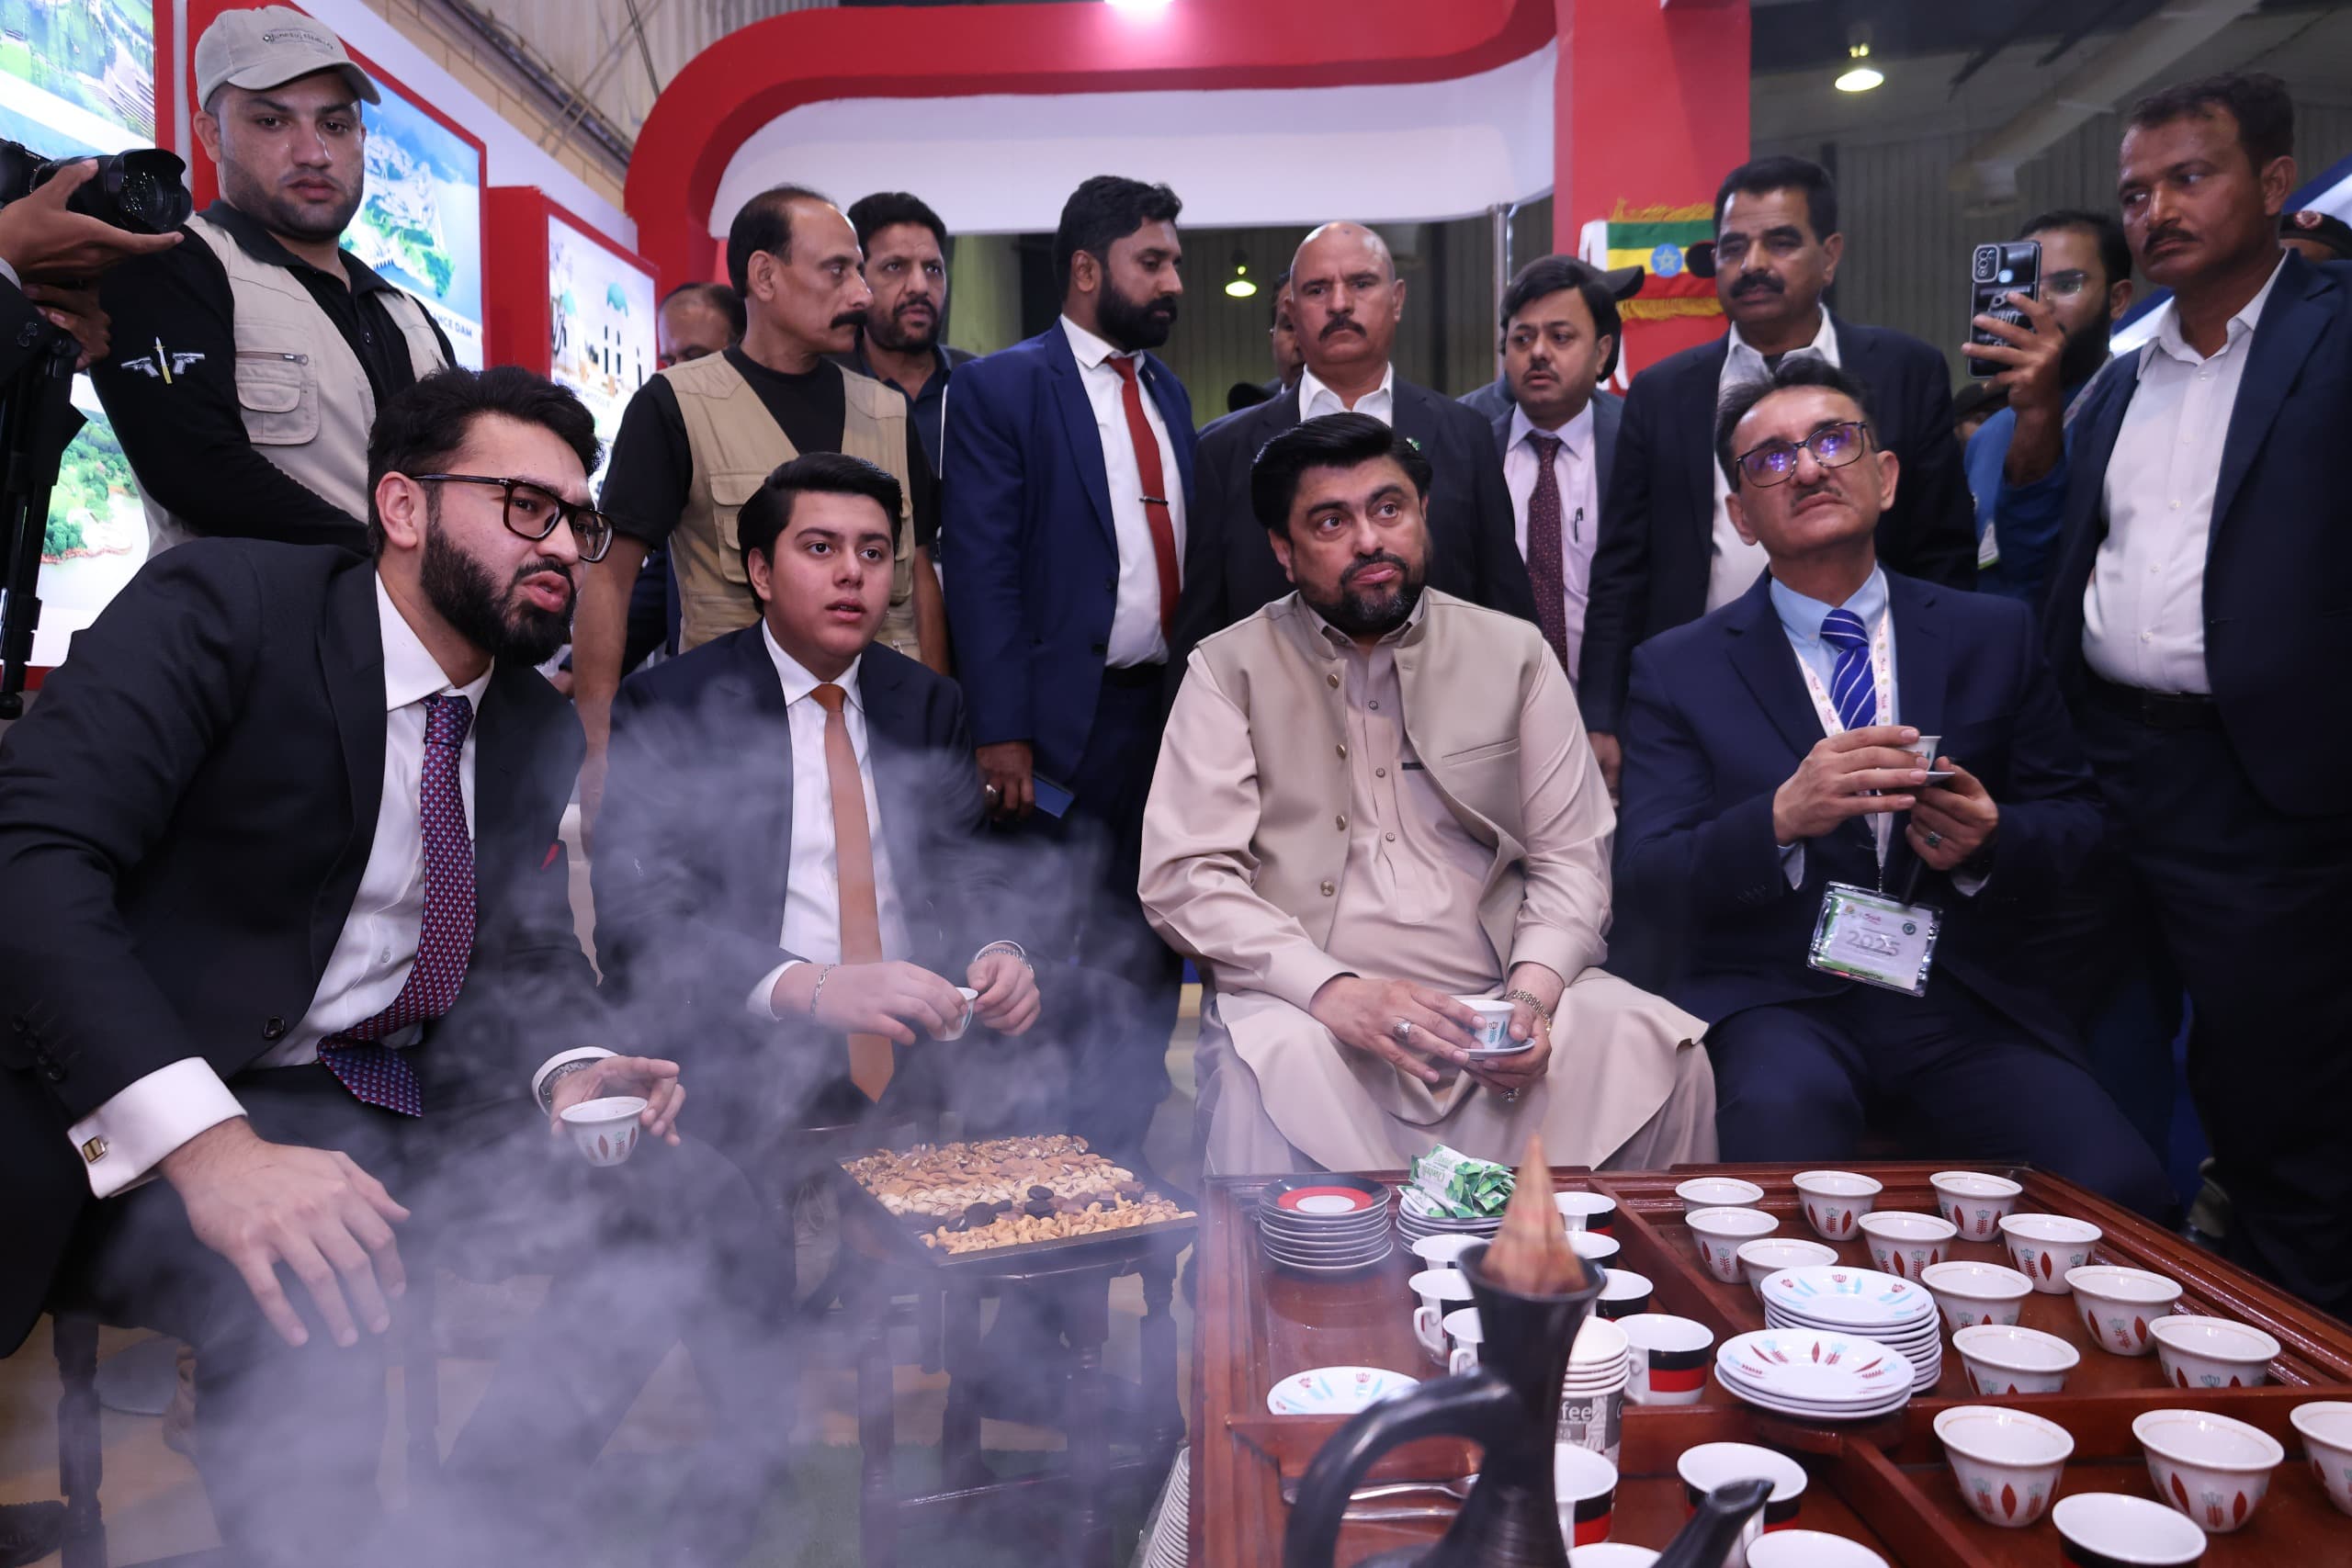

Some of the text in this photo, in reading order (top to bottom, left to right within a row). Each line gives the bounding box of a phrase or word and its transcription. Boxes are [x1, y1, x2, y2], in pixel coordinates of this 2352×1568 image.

[455, 322, 472, 338] DAM
[1846, 930, 1901, 956] 2025
[1561, 1401, 1592, 1421] fee
